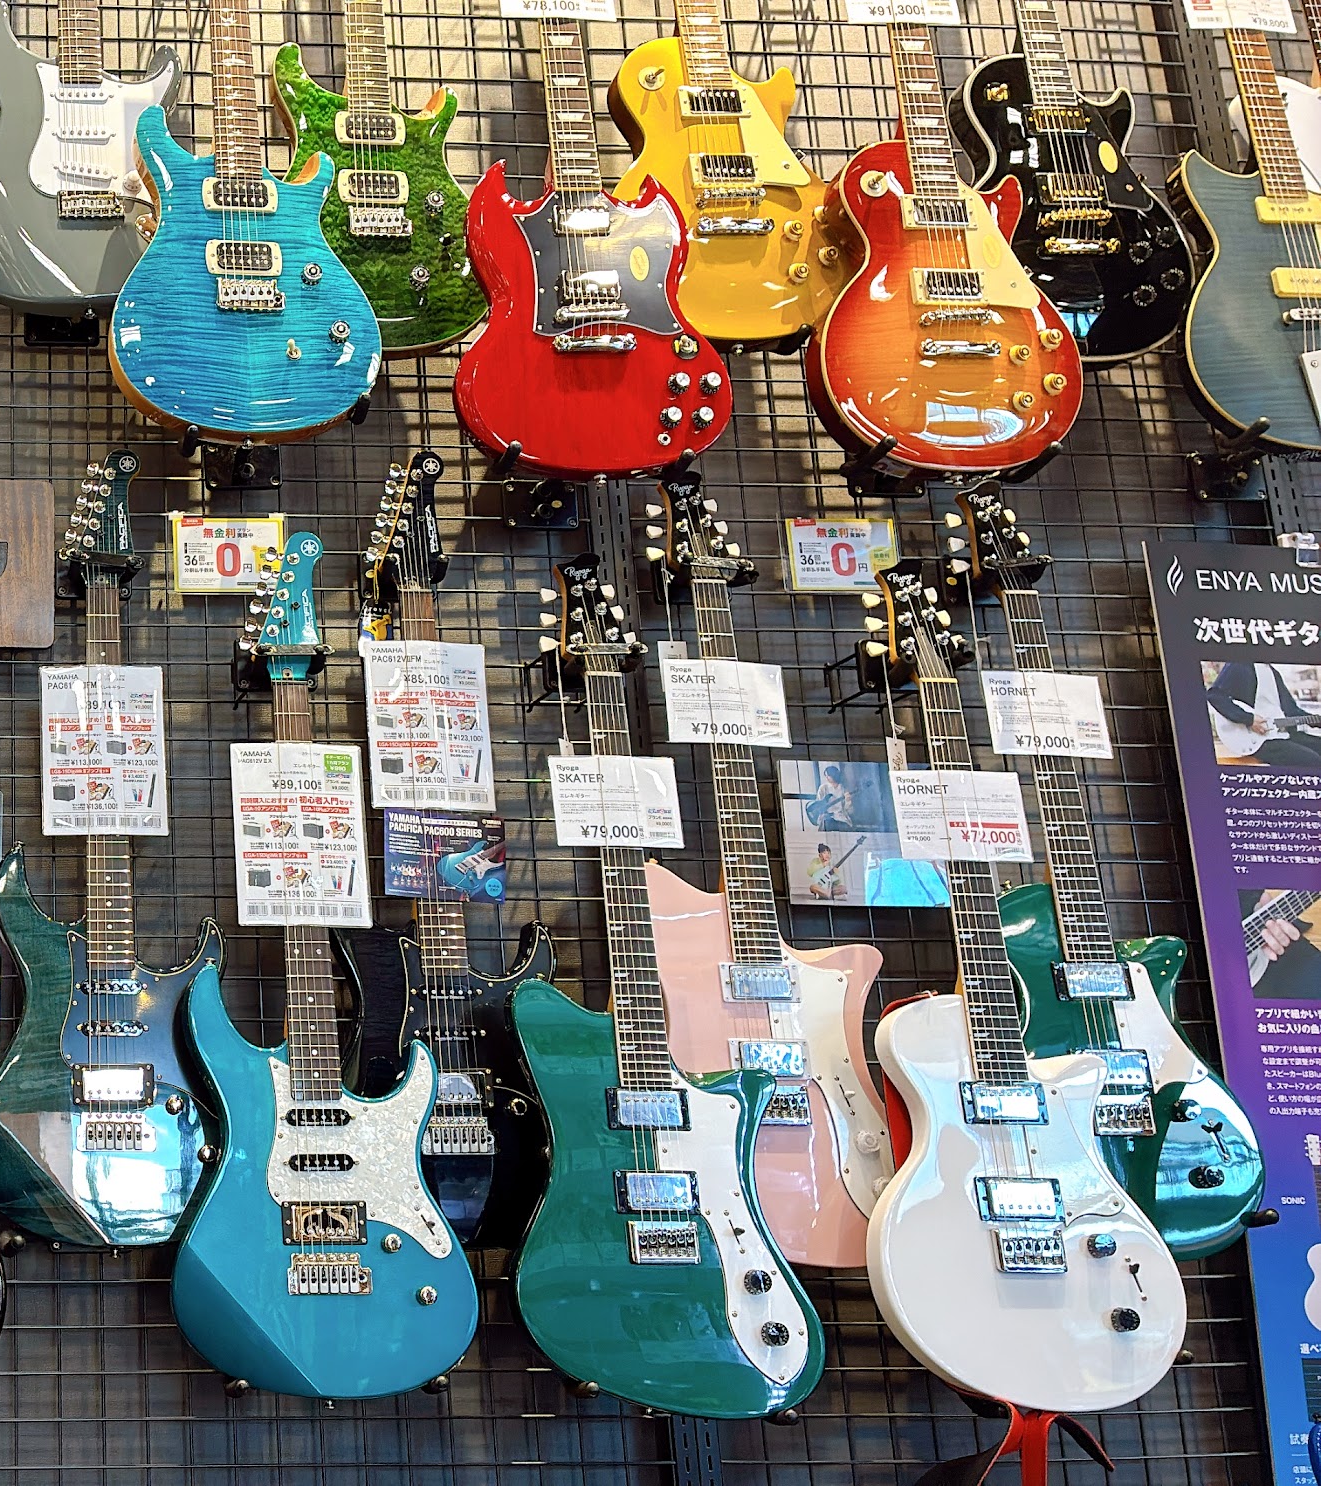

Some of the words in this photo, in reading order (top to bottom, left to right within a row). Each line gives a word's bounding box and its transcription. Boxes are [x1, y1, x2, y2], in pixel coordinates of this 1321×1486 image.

[868, 5, 920, 16] ¥91,300
[668, 482, 695, 496] Ryoga
[968, 493, 995, 506] Ryoga
[203, 527, 236, 539] 無金利
[816, 527, 849, 538] 無金利
[183, 555, 198, 566] 36
[215, 542, 241, 577] 0
[800, 555, 814, 566] 36
[830, 542, 857, 577] 0
[242, 563, 253, 573] 円
[564, 566, 592, 580] Ryoga
[858, 562, 869, 573] 円
[887, 573, 915, 586] Ryoga
[1196, 569, 1263, 592] ENYA
[670, 665, 692, 673] Ryoga
[403, 674, 446, 685] ¥89,100
[671, 674, 716, 684] SKATER
[989, 677, 1011, 685] Ryoga
[990, 686, 1036, 697] HORNET
[691, 722, 747, 737] ¥79,000
[1015, 734, 1070, 750] ¥79,000
[556, 764, 580, 772] Ryoga
[558, 773, 605, 783] SKATER
[895, 776, 921, 784] Ryoga
[272, 779, 318, 791] ¥89,100
[897, 784, 949, 795] HORNET
[388, 812, 421, 825] YAMAHA
[388, 821, 423, 835] PACIFICA
[424, 826, 455, 837] PAC600
[455, 828, 483, 839] SERIES
[580, 825, 639, 840] ¥79,000
[960, 829, 1017, 845] ¥72,000
[1280, 1196, 1306, 1205] SONIC
